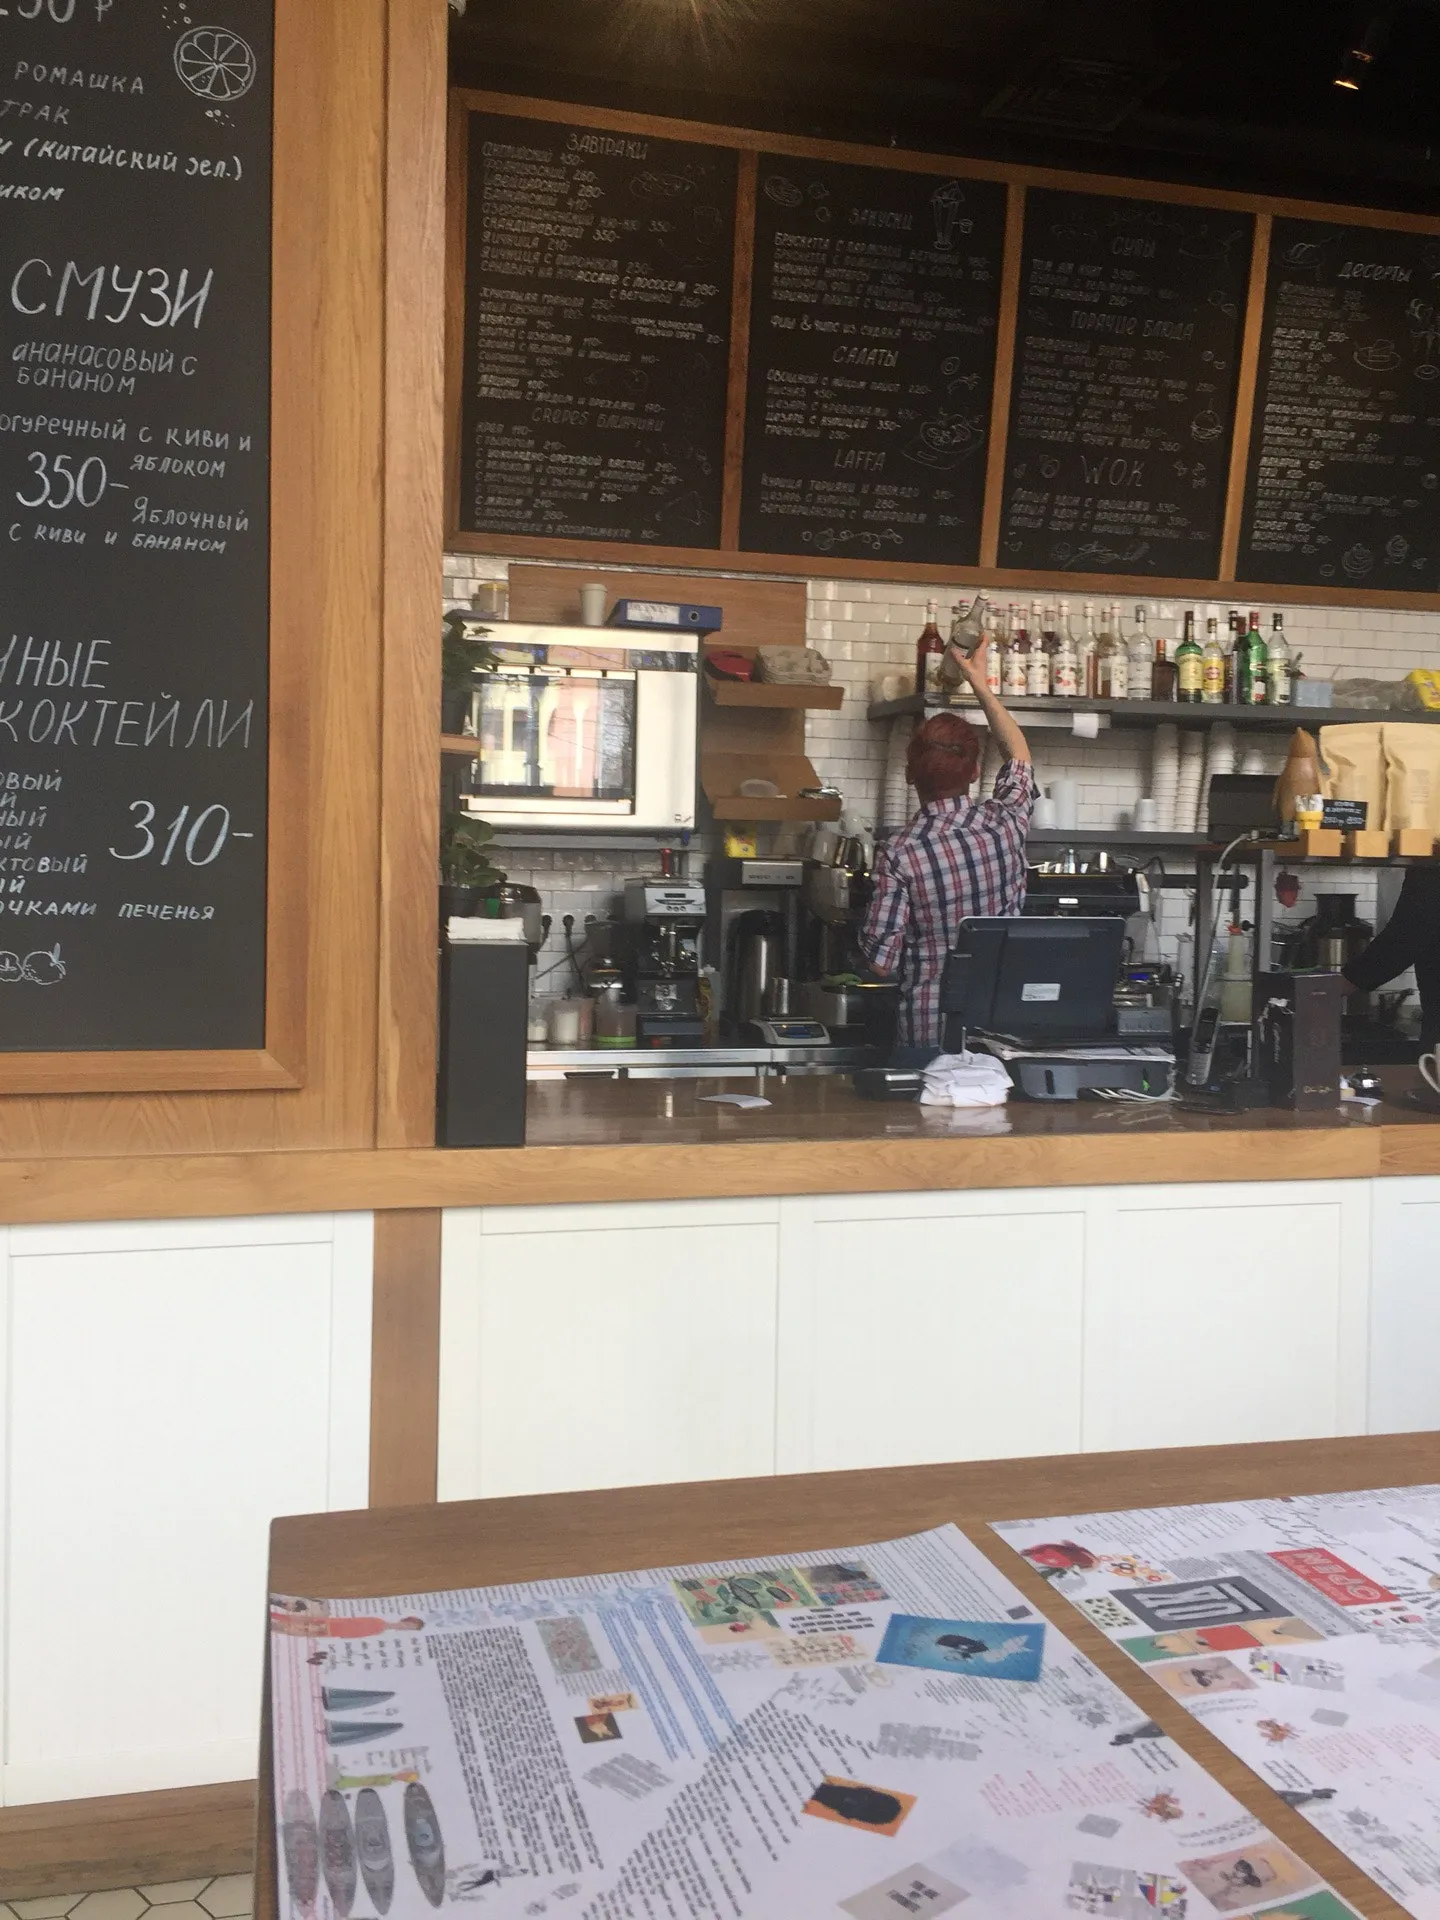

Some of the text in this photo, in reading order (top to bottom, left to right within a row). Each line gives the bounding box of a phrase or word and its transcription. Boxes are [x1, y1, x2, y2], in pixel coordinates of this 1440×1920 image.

[14, 61, 144, 95] РОМАШКА
[11, 258, 214, 329] СМУЗИ
[832, 346, 898, 367] САЛАТЫ
[834, 448, 886, 472] LAFFA
[1080, 455, 1146, 487] WOK
[118, 902, 215, 921] ПЕЧЕНЬЯ
